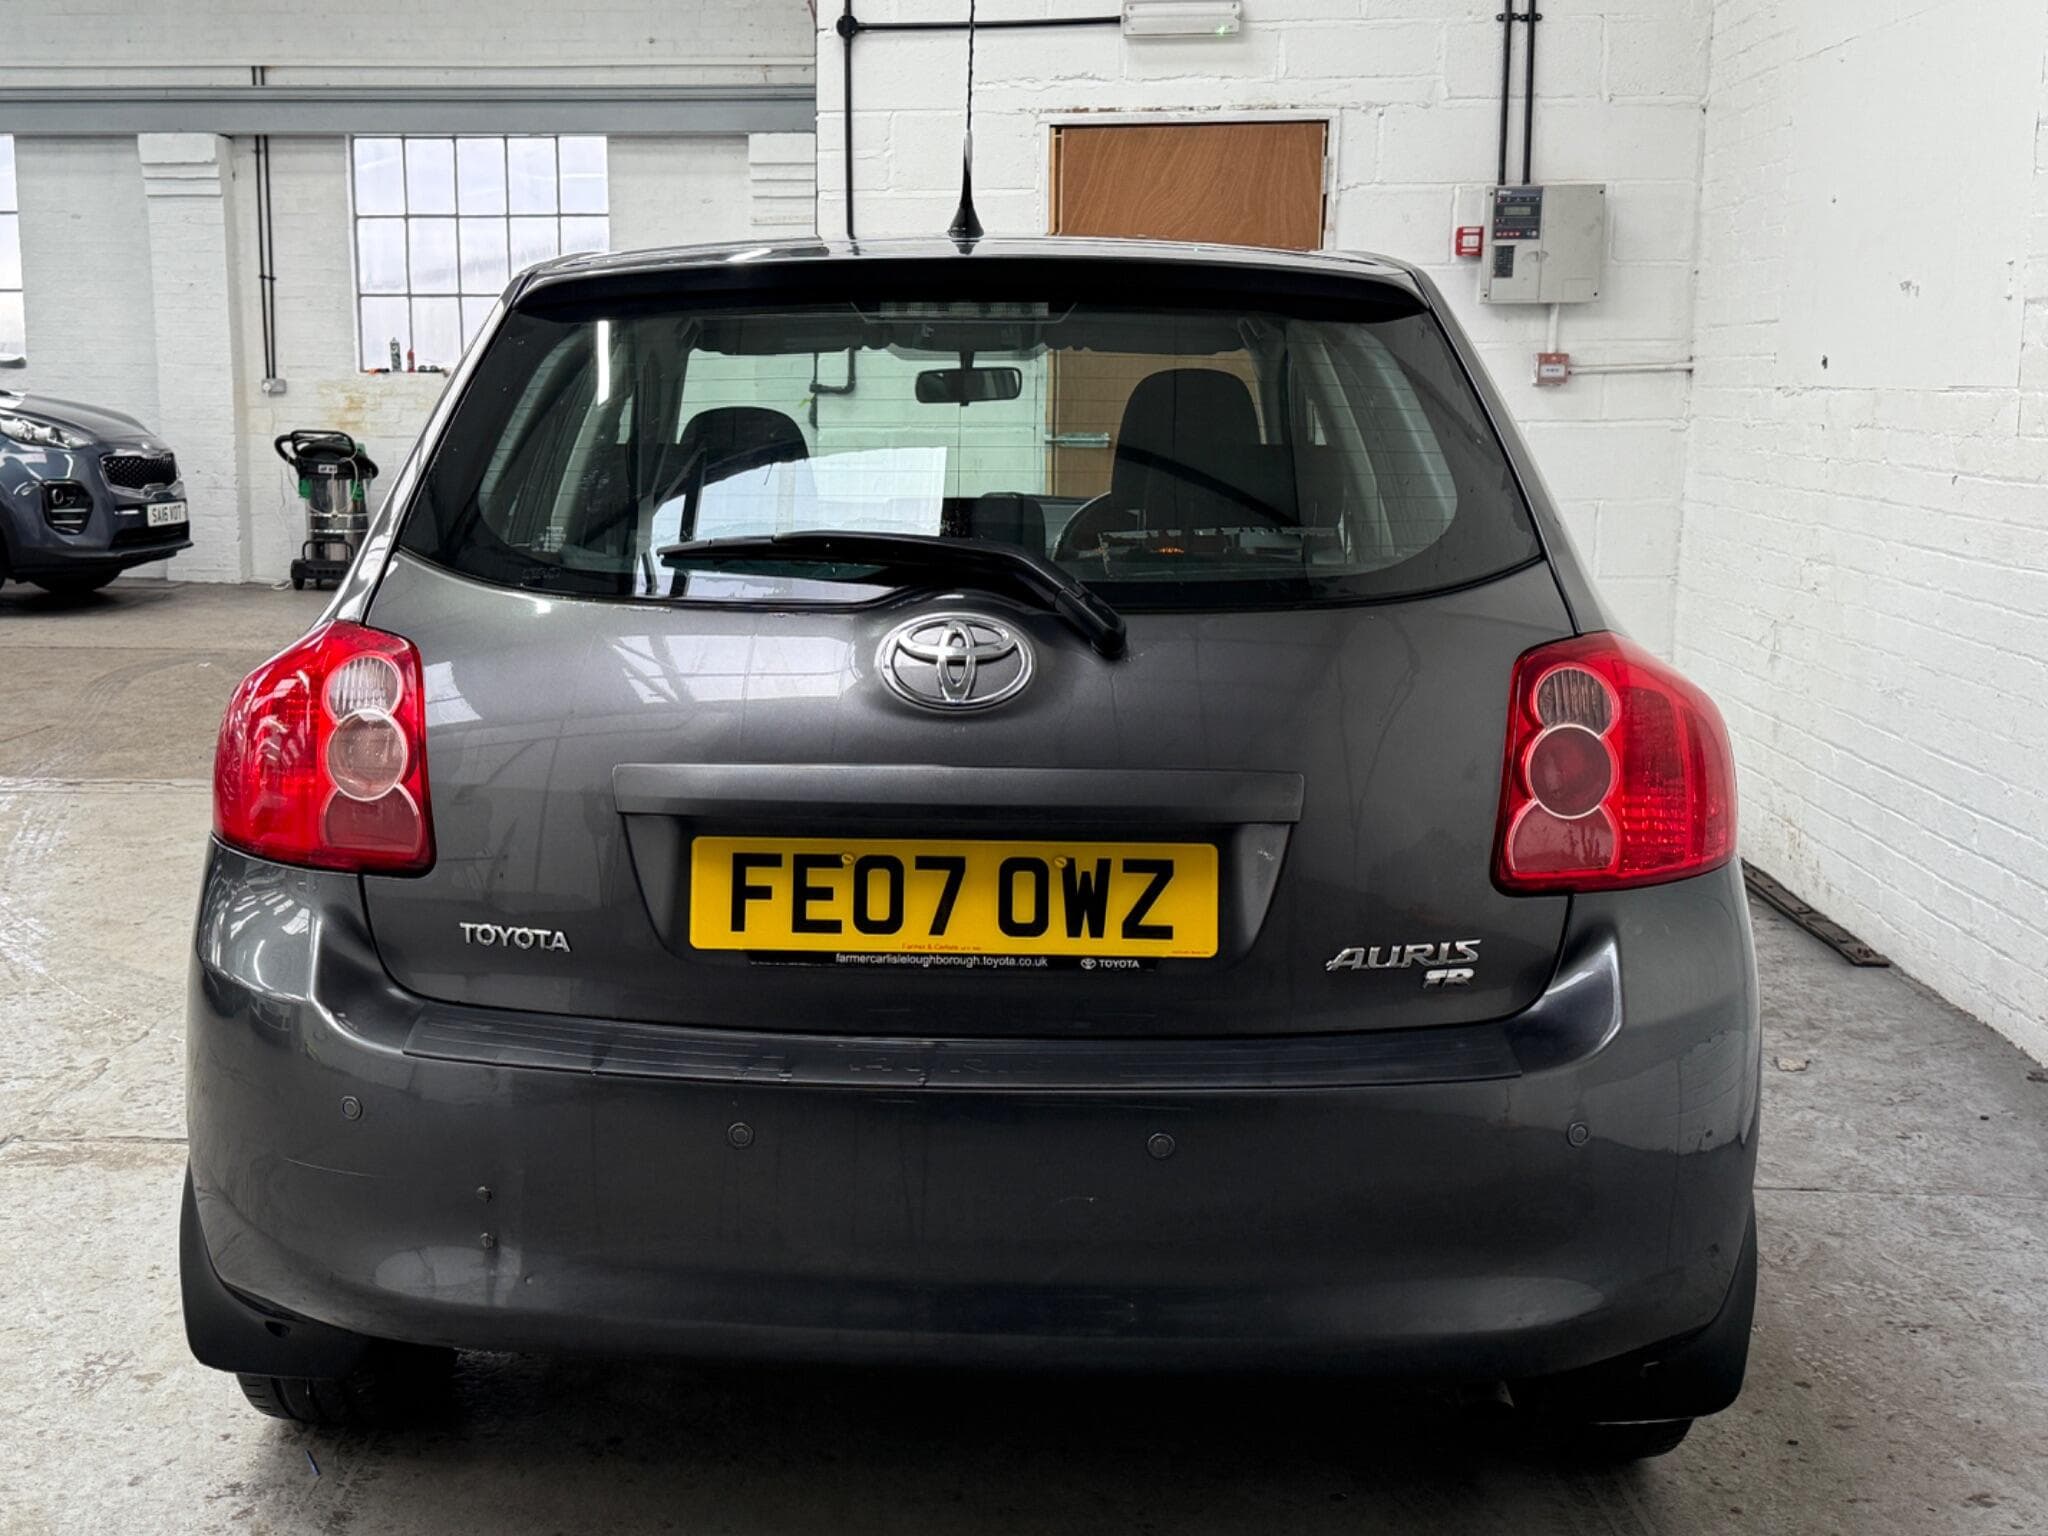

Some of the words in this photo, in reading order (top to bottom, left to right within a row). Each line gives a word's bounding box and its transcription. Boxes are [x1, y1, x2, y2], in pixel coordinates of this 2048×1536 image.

[730, 852, 966, 936] FE07
[998, 856, 1174, 940] OWZ
[459, 921, 571, 953] TOYOTA
[1099, 959, 1140, 969] TOYOTA
[1325, 938, 1482, 972] AURIS
